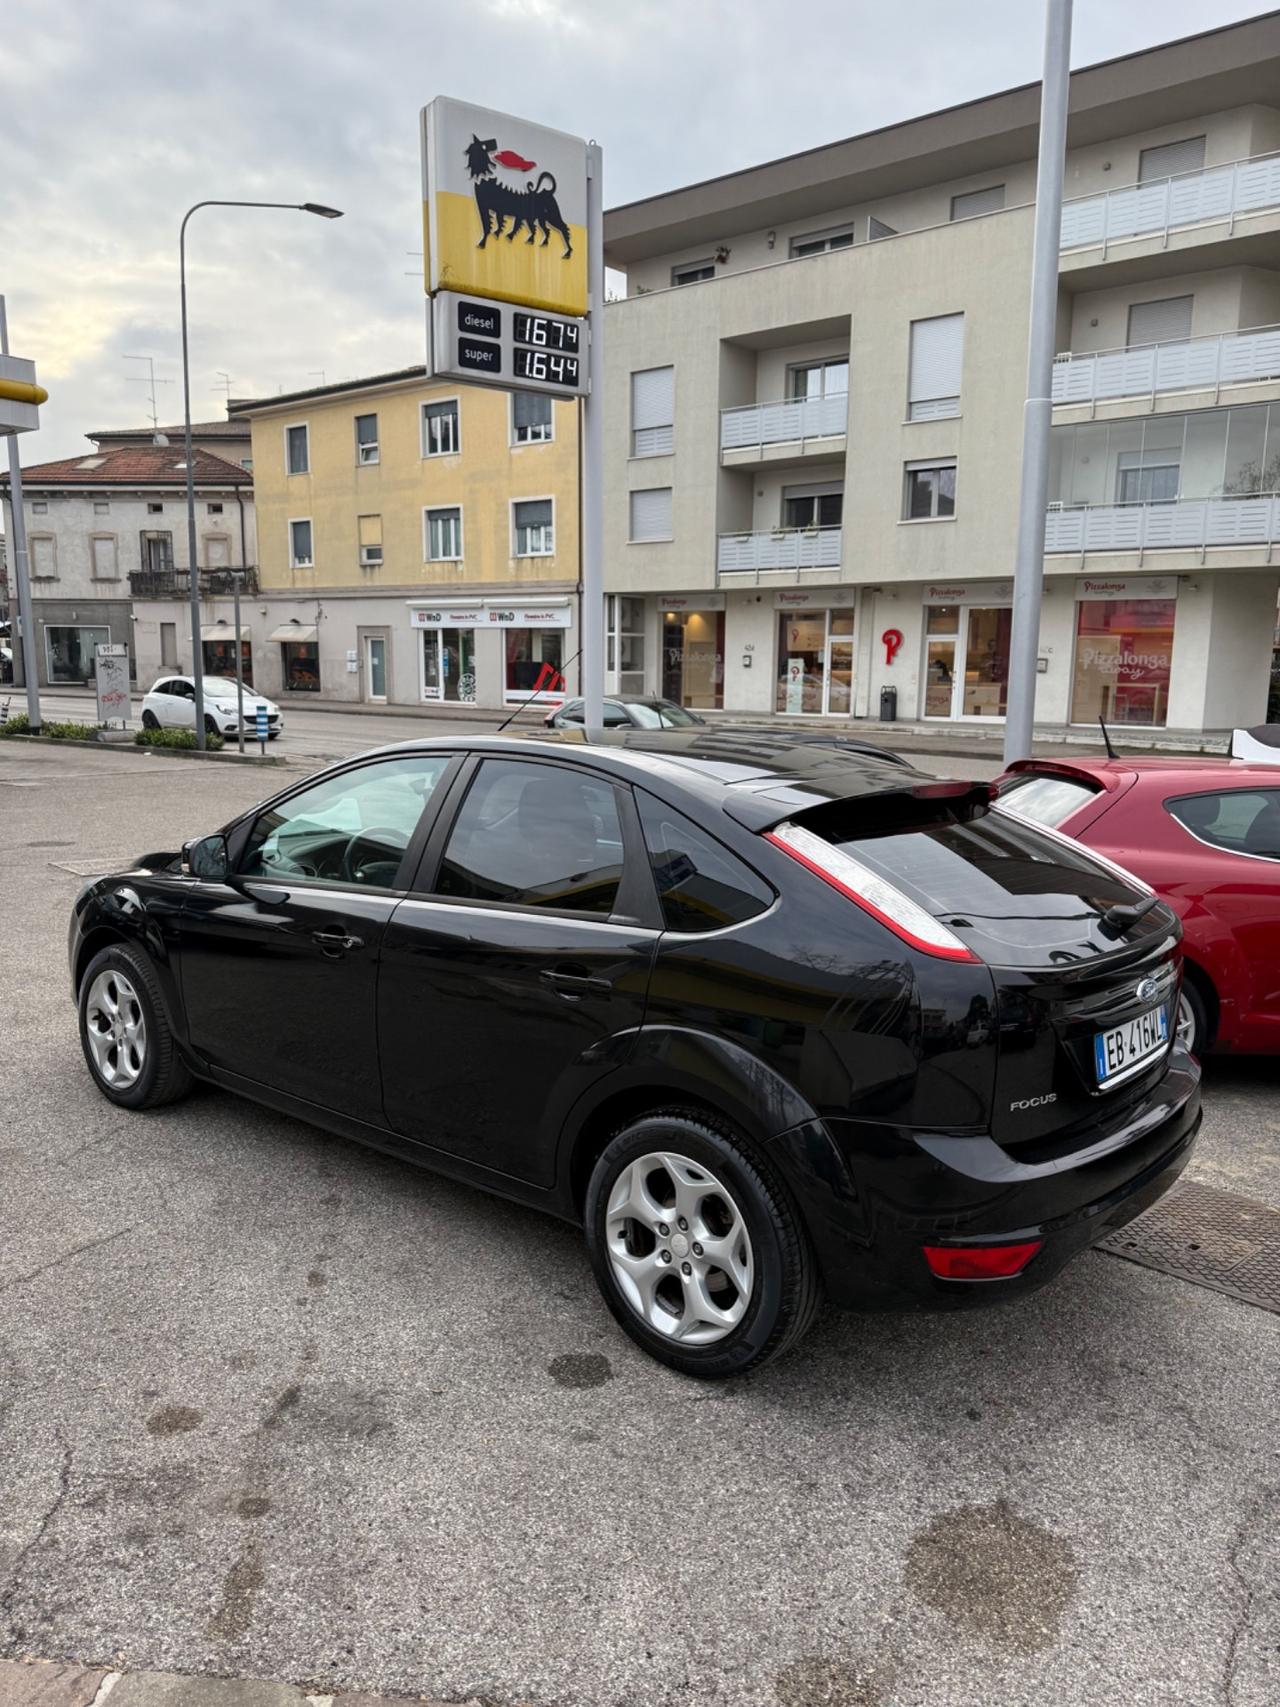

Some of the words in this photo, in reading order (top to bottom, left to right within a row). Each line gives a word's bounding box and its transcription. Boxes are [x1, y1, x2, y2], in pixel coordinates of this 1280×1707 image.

[464, 314, 494, 329] diesel
[464, 348, 493, 362] super
[1084, 581, 1126, 592] Pizzalonga
[1082, 648, 1168, 669] Pizzalonga
[1097, 665, 1144, 680] away
[1010, 1093, 1057, 1112] FOCUS
